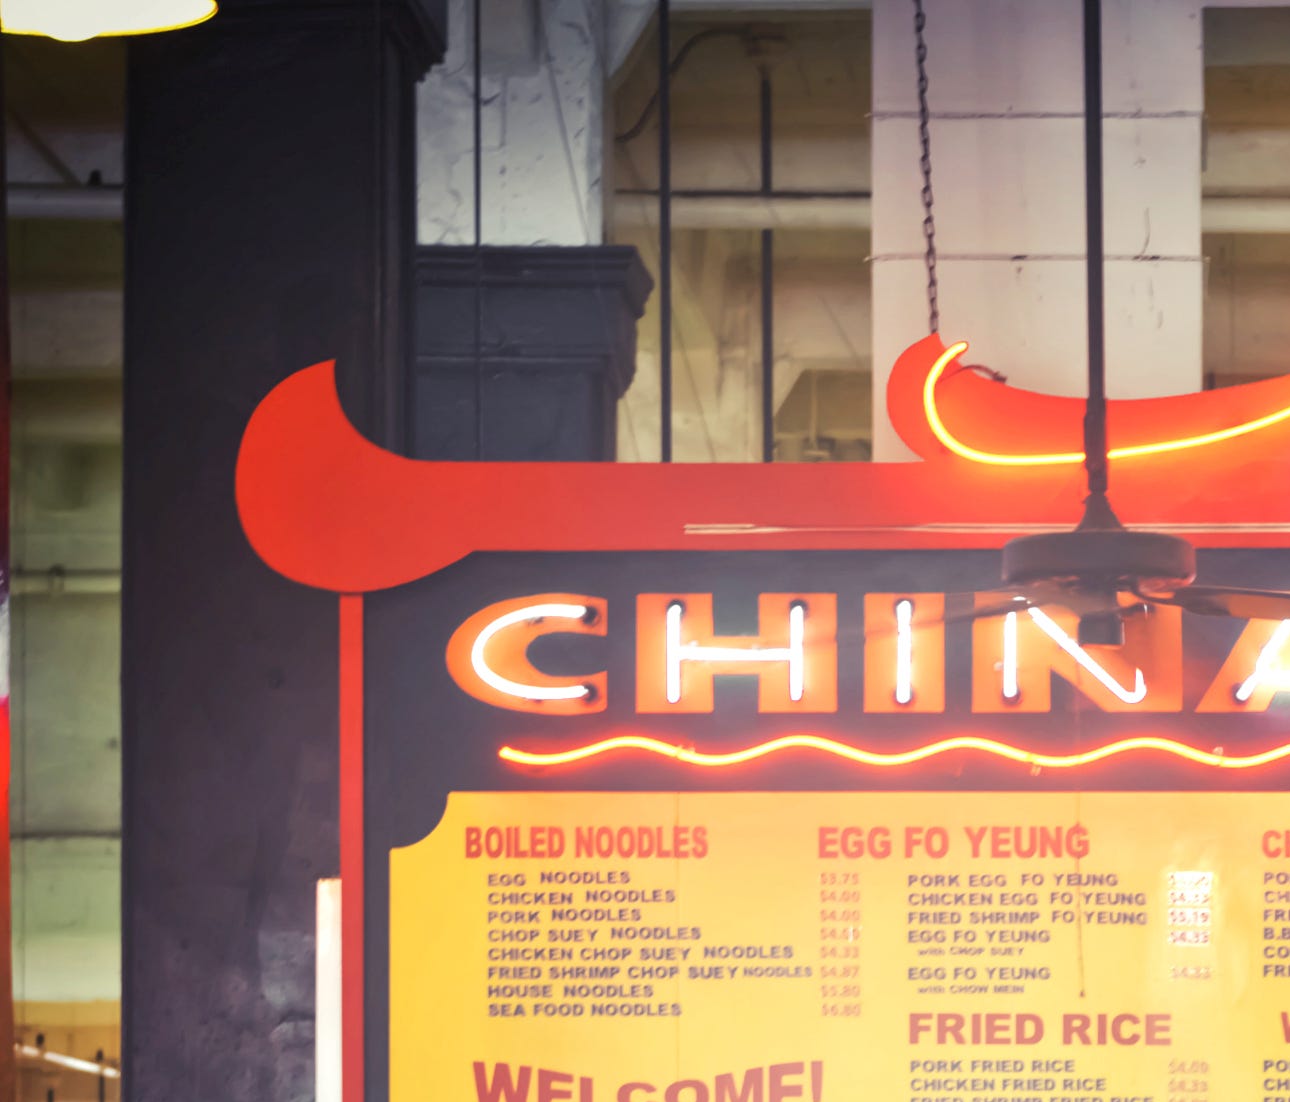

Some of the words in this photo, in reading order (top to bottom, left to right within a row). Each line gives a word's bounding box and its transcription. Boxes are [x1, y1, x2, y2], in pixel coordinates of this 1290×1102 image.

[465, 826, 565, 859] BOILED
[575, 825, 708, 859] NOODLES
[818, 826, 892, 859] EGG
[904, 826, 949, 859] FO
[964, 826, 1089, 859] YEUNG
[488, 873, 526, 886] EGG
[540, 871, 630, 884] NOODLES
[908, 875, 960, 887] PORK
[969, 874, 1007, 887] EGG
[1021, 873, 1044, 886] FO
[1054, 873, 1118, 886] YEUNG
[488, 892, 573, 905] CHICKEN
[586, 889, 675, 903] NOODLES
[908, 893, 992, 906] CHICKEN
[1000, 893, 1038, 906] EGG
[1050, 892, 1073, 905] FO
[1082, 893, 1146, 906] YEUNG
[488, 911, 540, 923] PORK
[552, 908, 641, 922] NOODLES
[908, 912, 961, 924] FRIED
[970, 911, 1040, 924] SHRIMP
[1052, 911, 1075, 924] FO
[1084, 911, 1147, 925] YEUNG
[488, 929, 540, 942] CHOP
[548, 929, 598, 942] SUEY
[611, 927, 701, 940] NOODLES
[908, 930, 946, 943] EGG
[954, 930, 977, 943] FO
[986, 930, 1050, 943] YEUNG
[488, 948, 573, 961] CHICKEN
[580, 948, 632, 961] CHOP
[640, 947, 691, 961] SUEY
[704, 946, 793, 959] NOODLES
[488, 966, 542, 979] FRIED
[549, 966, 620, 979] SHRIMP
[628, 966, 679, 979] CHOP
[688, 966, 738, 980] SUEY
[743, 966, 812, 977] NOODLES
[488, 985, 552, 998] HOUSE
[563, 985, 653, 998] NOODLES
[489, 1004, 526, 1017] SEA
[533, 1003, 584, 1017] FOOD
[591, 1003, 682, 1016] NOODLES
[909, 1013, 1044, 1045] FRIED
[1063, 1013, 1171, 1046] RICE
[910, 1060, 962, 1073] PORK
[971, 1060, 1024, 1073] FRIED
[1032, 1060, 1074, 1073] RICE
[910, 1079, 995, 1091] CHICKEN
[1002, 1078, 1056, 1091] FRIED
[1062, 1078, 1106, 1091] RICE
